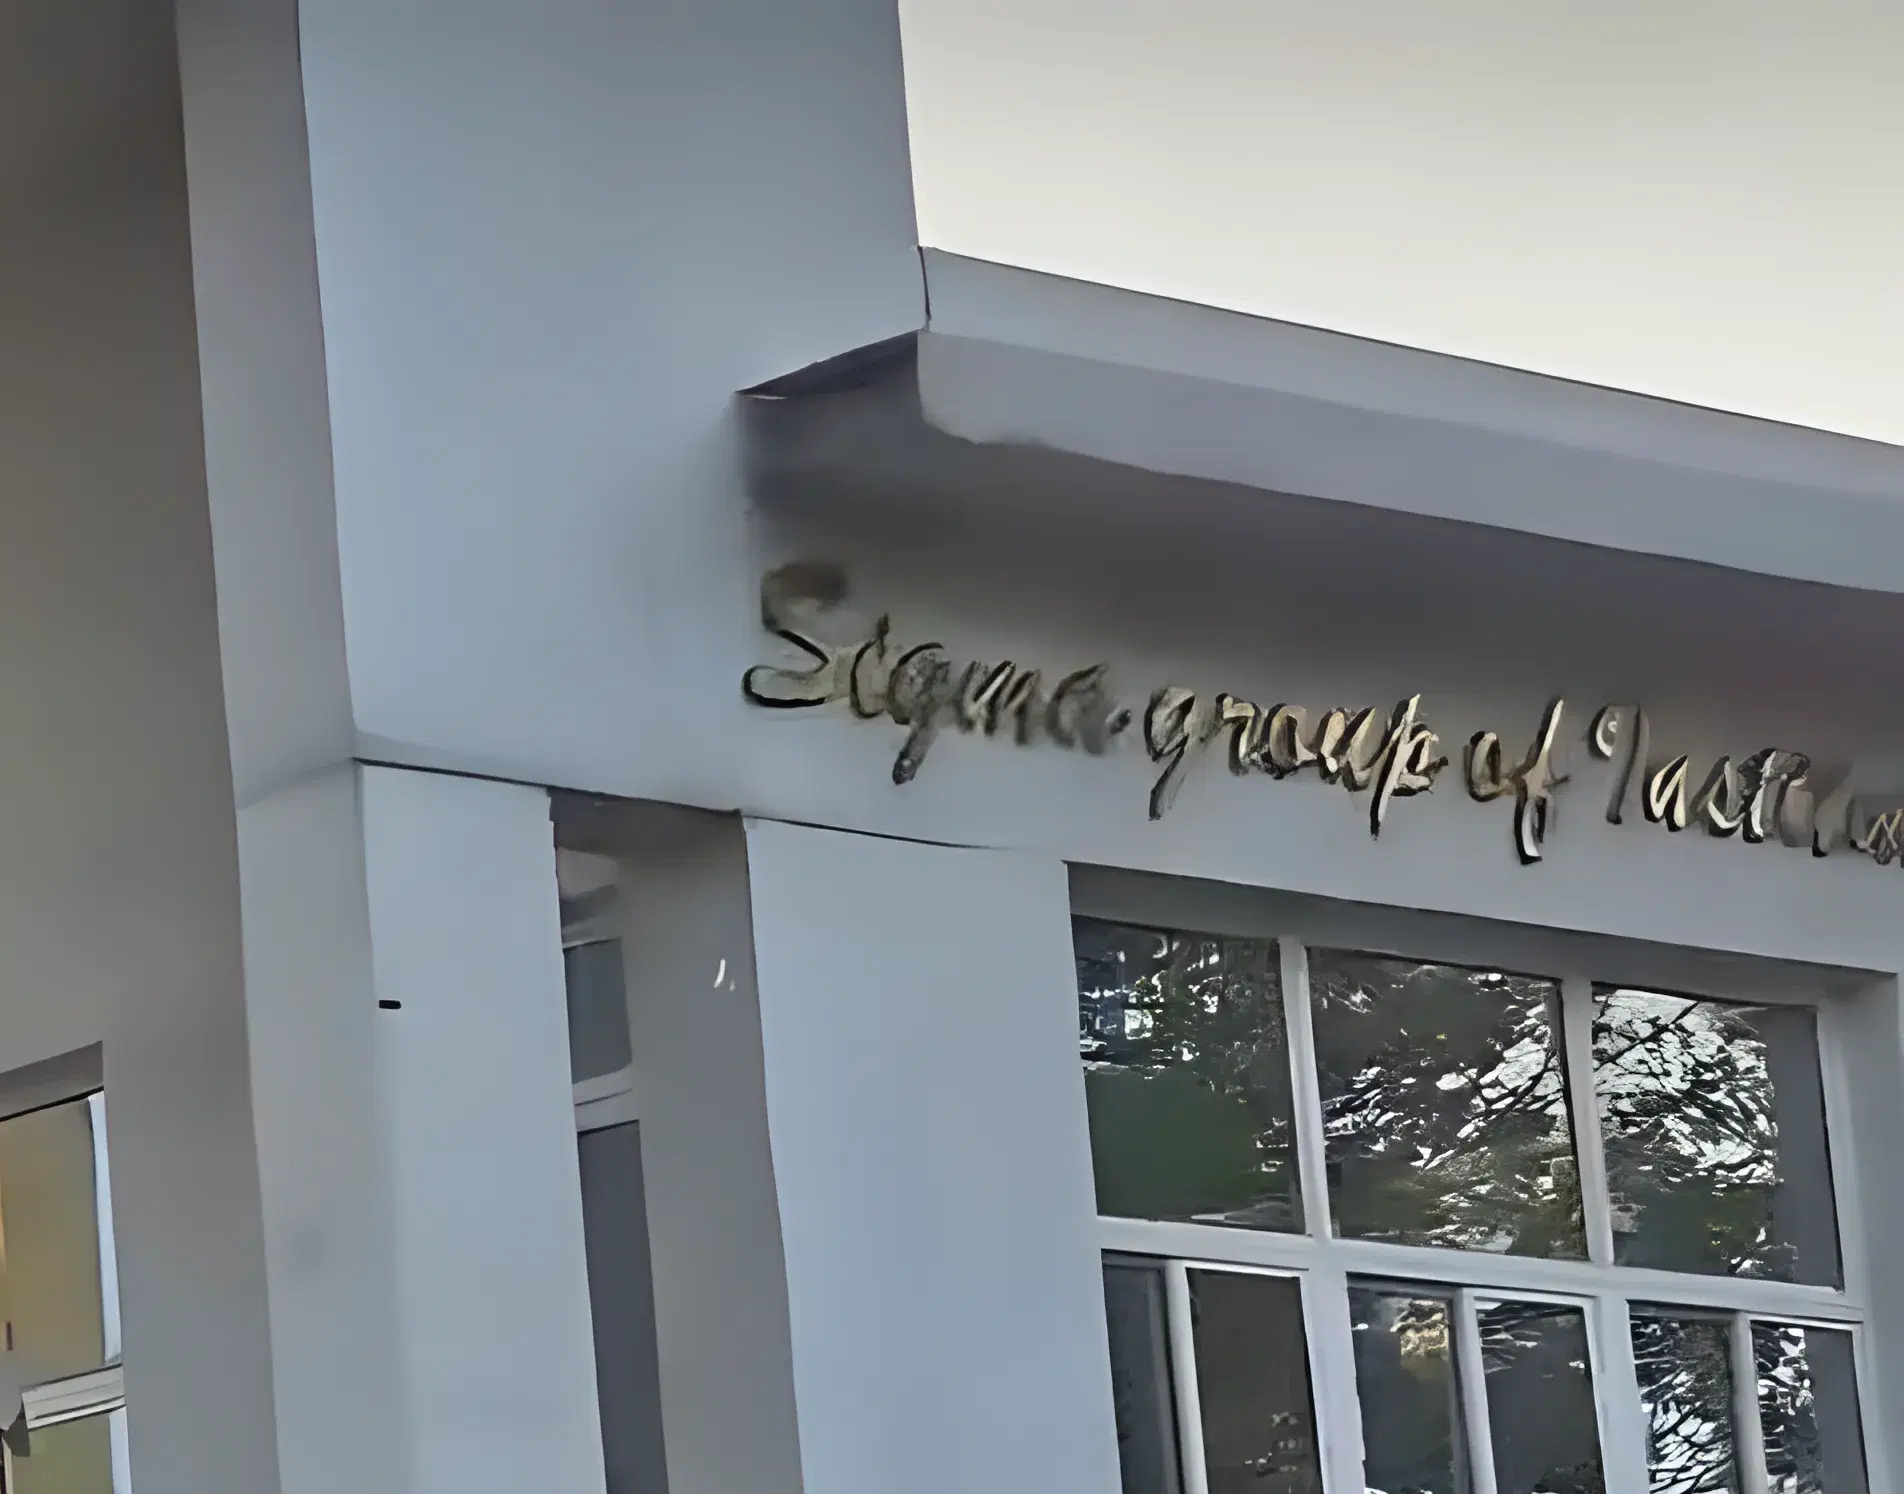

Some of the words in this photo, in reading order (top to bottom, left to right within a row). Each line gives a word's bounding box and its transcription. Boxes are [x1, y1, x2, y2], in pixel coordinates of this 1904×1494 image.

[741, 562, 1131, 786] Sigma
[1143, 688, 1448, 842] group
[1465, 696, 1571, 866] of
